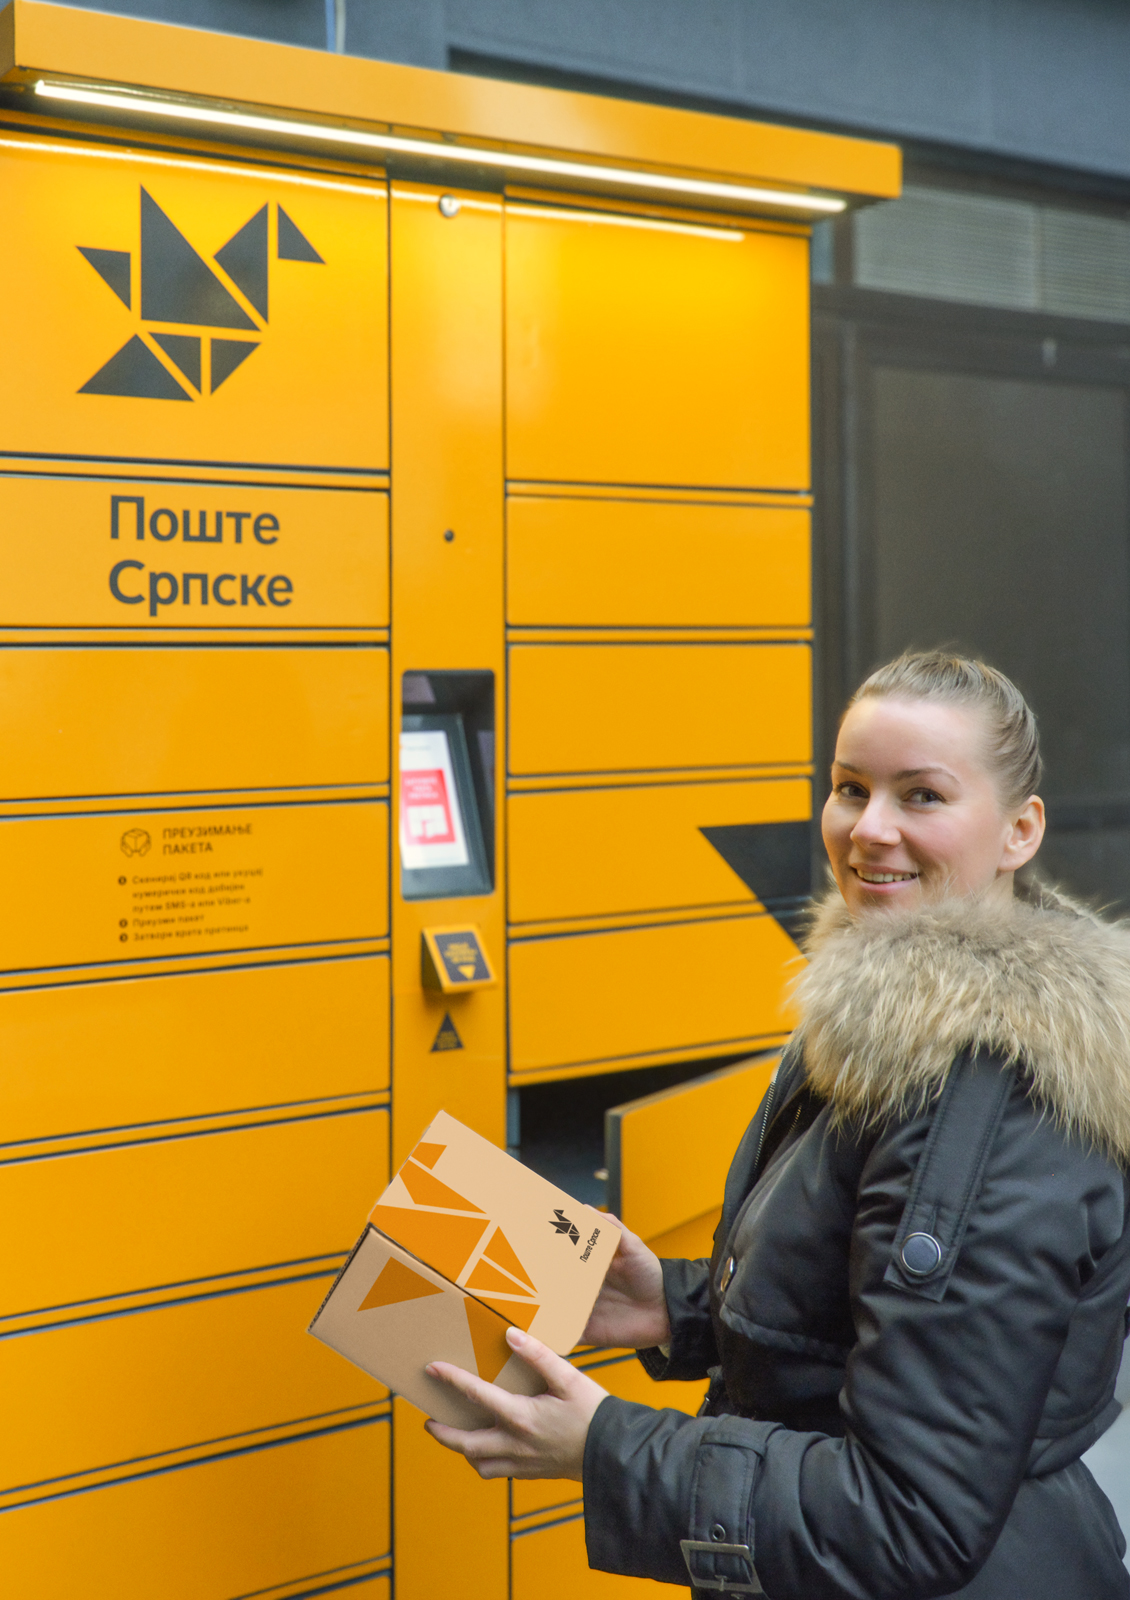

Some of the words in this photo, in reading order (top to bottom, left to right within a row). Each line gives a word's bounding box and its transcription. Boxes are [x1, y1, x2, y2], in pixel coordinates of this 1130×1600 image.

[110, 494, 281, 546] Поште
[108, 558, 295, 618] Српске
[162, 823, 253, 840] ПРЕУЗИМАЊЕ
[162, 842, 214, 856] ПАКЕТА
[579, 1244, 593, 1263] Поште
[587, 1227, 601, 1246] Српске
